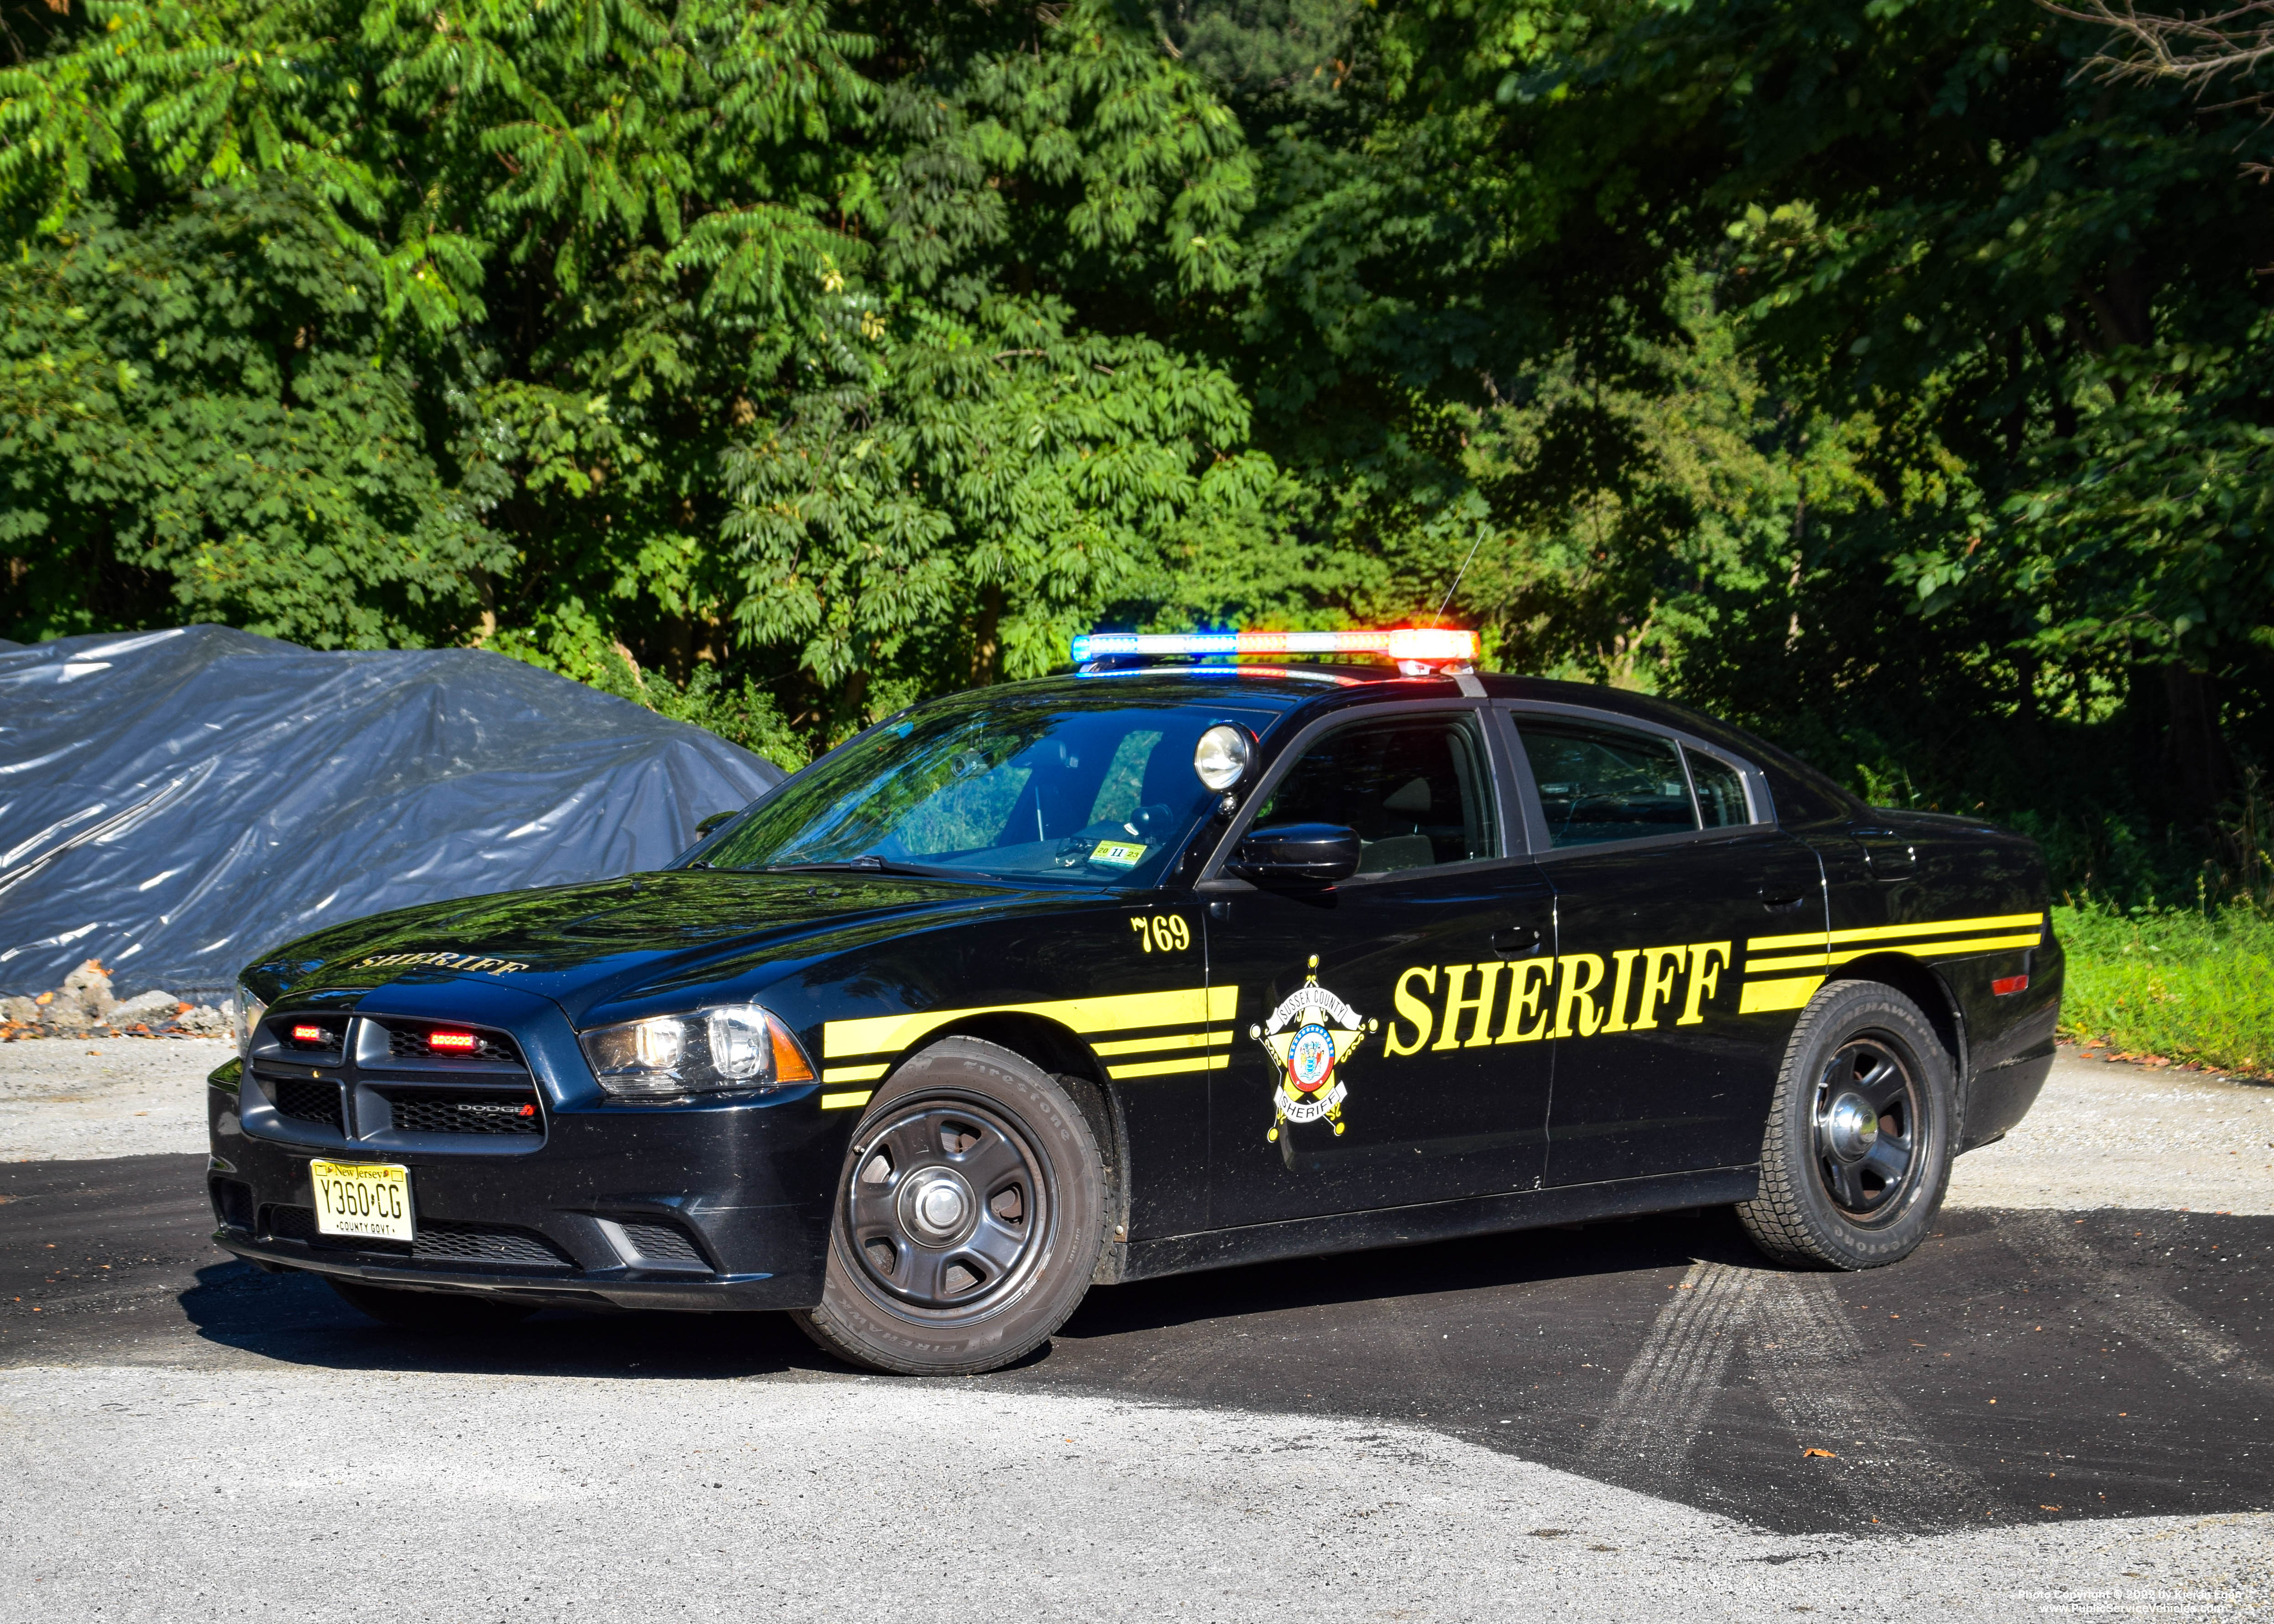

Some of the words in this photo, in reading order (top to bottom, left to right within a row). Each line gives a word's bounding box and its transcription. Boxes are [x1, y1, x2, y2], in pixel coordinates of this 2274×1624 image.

[1111, 848, 1124, 857] 11
[1130, 915, 1190, 952] 769
[349, 952, 530, 976] SHERIFF
[1280, 990, 1311, 1020] SUSSEX
[1314, 990, 1344, 1017] COUNTY
[1384, 941, 1732, 1057] SHERIFF
[458, 1104, 527, 1113] DODGE
[963, 1061, 1070, 1141] Firestone
[1281, 1091, 1336, 1119] SHERIFF
[334, 1165, 354, 1177] New
[355, 1166, 383, 1181] Jersey
[339, 1221, 369, 1233] COUNTY
[370, 1223, 390, 1234] GOVT
[1067, 1228, 1081, 1263] OUTSIDE
[839, 1299, 957, 1353] FIREHAWK
